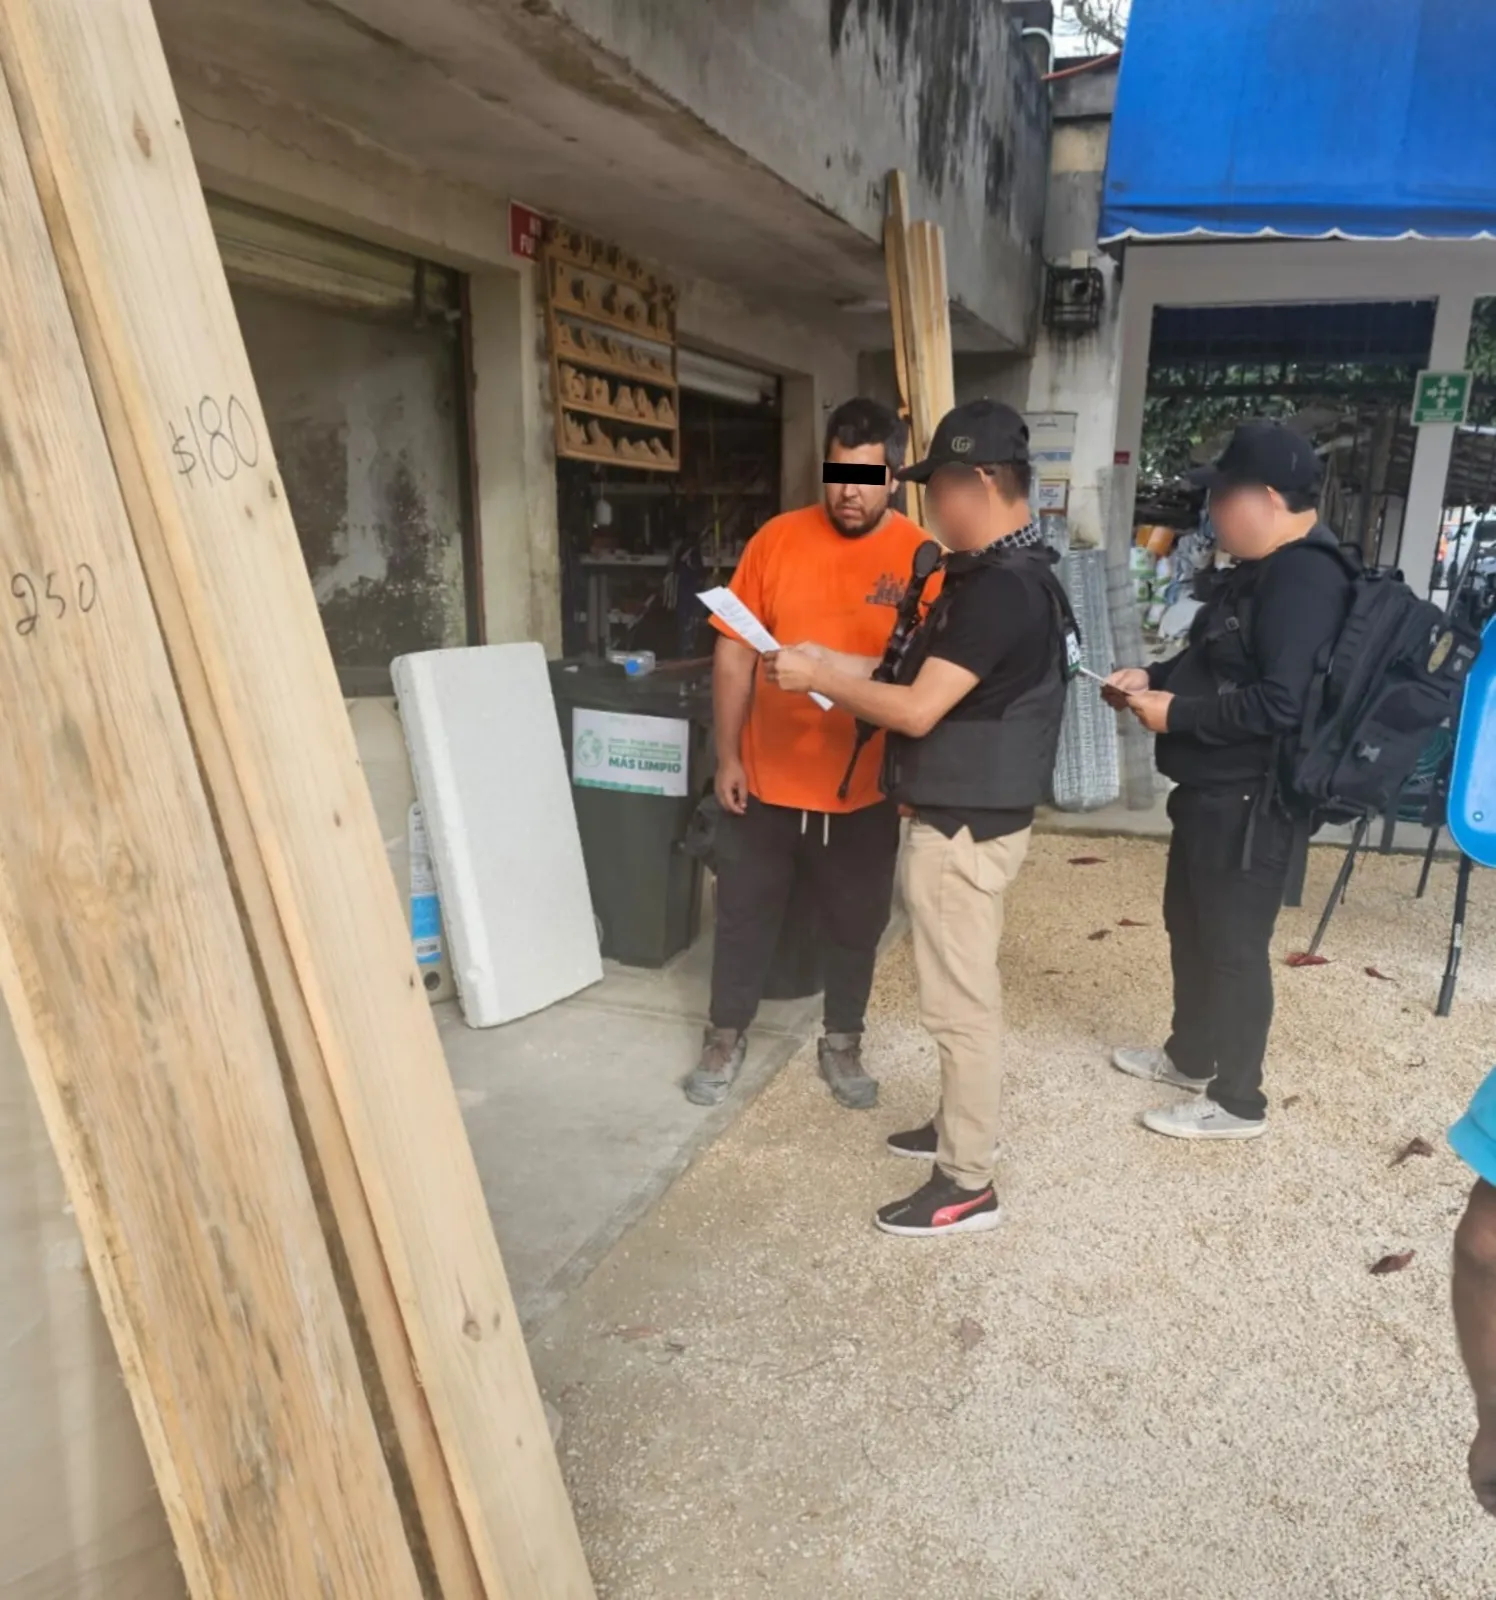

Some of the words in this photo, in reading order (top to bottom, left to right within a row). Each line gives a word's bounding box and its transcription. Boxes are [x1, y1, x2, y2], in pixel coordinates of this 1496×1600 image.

[168, 394, 259, 489] $180
[11, 563, 96, 636] 250
[608, 755, 635, 770] MÁS
[638, 759, 682, 774] LIMPIO
